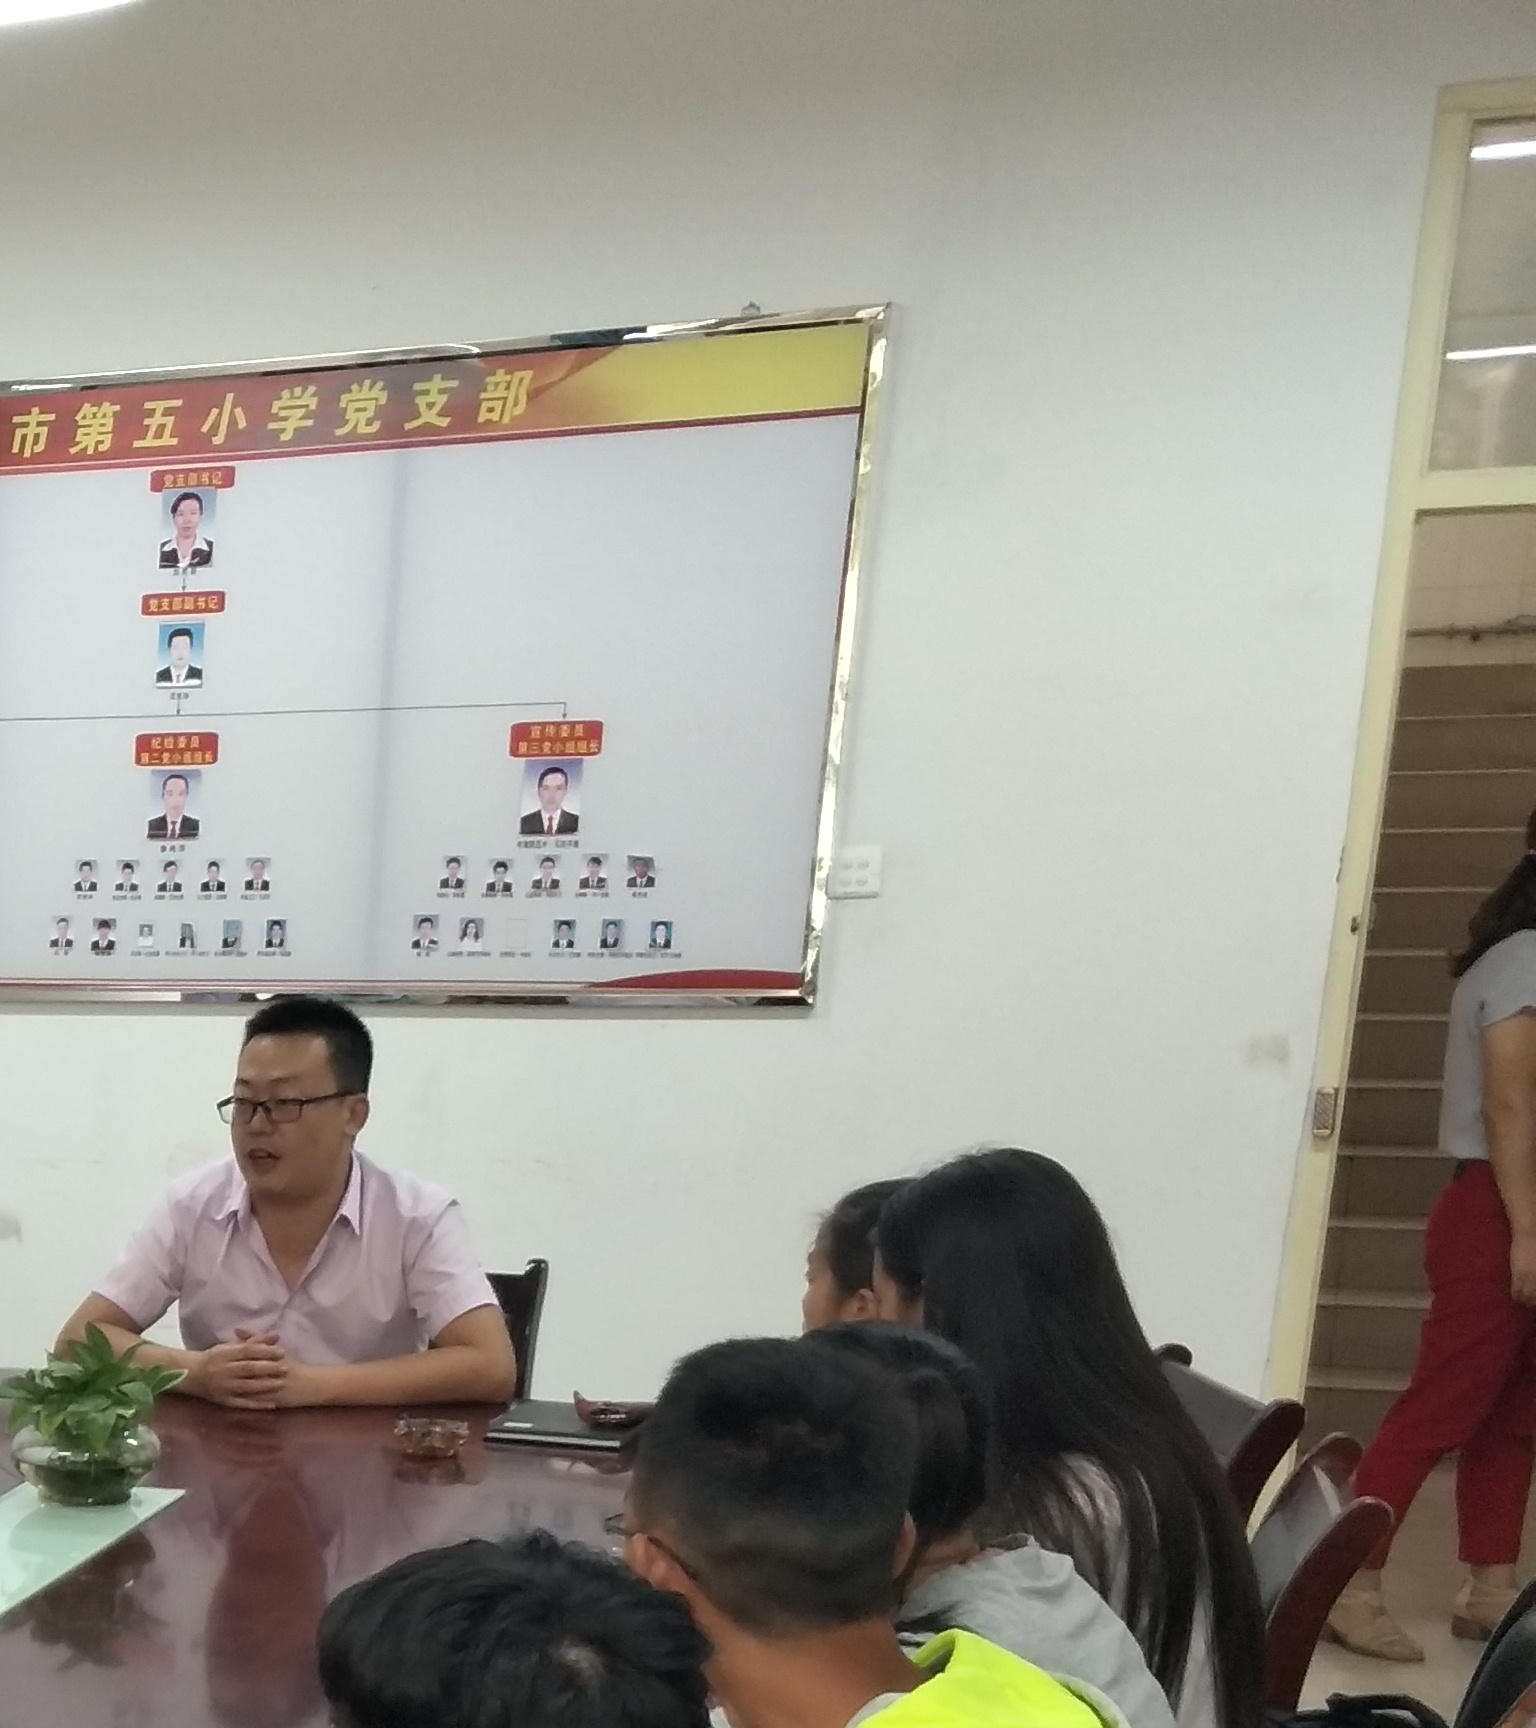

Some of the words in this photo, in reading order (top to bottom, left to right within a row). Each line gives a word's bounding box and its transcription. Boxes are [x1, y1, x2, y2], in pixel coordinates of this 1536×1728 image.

[163, 472, 222, 488] 党支部书记
[148, 595, 219, 612] 党支部副书记
